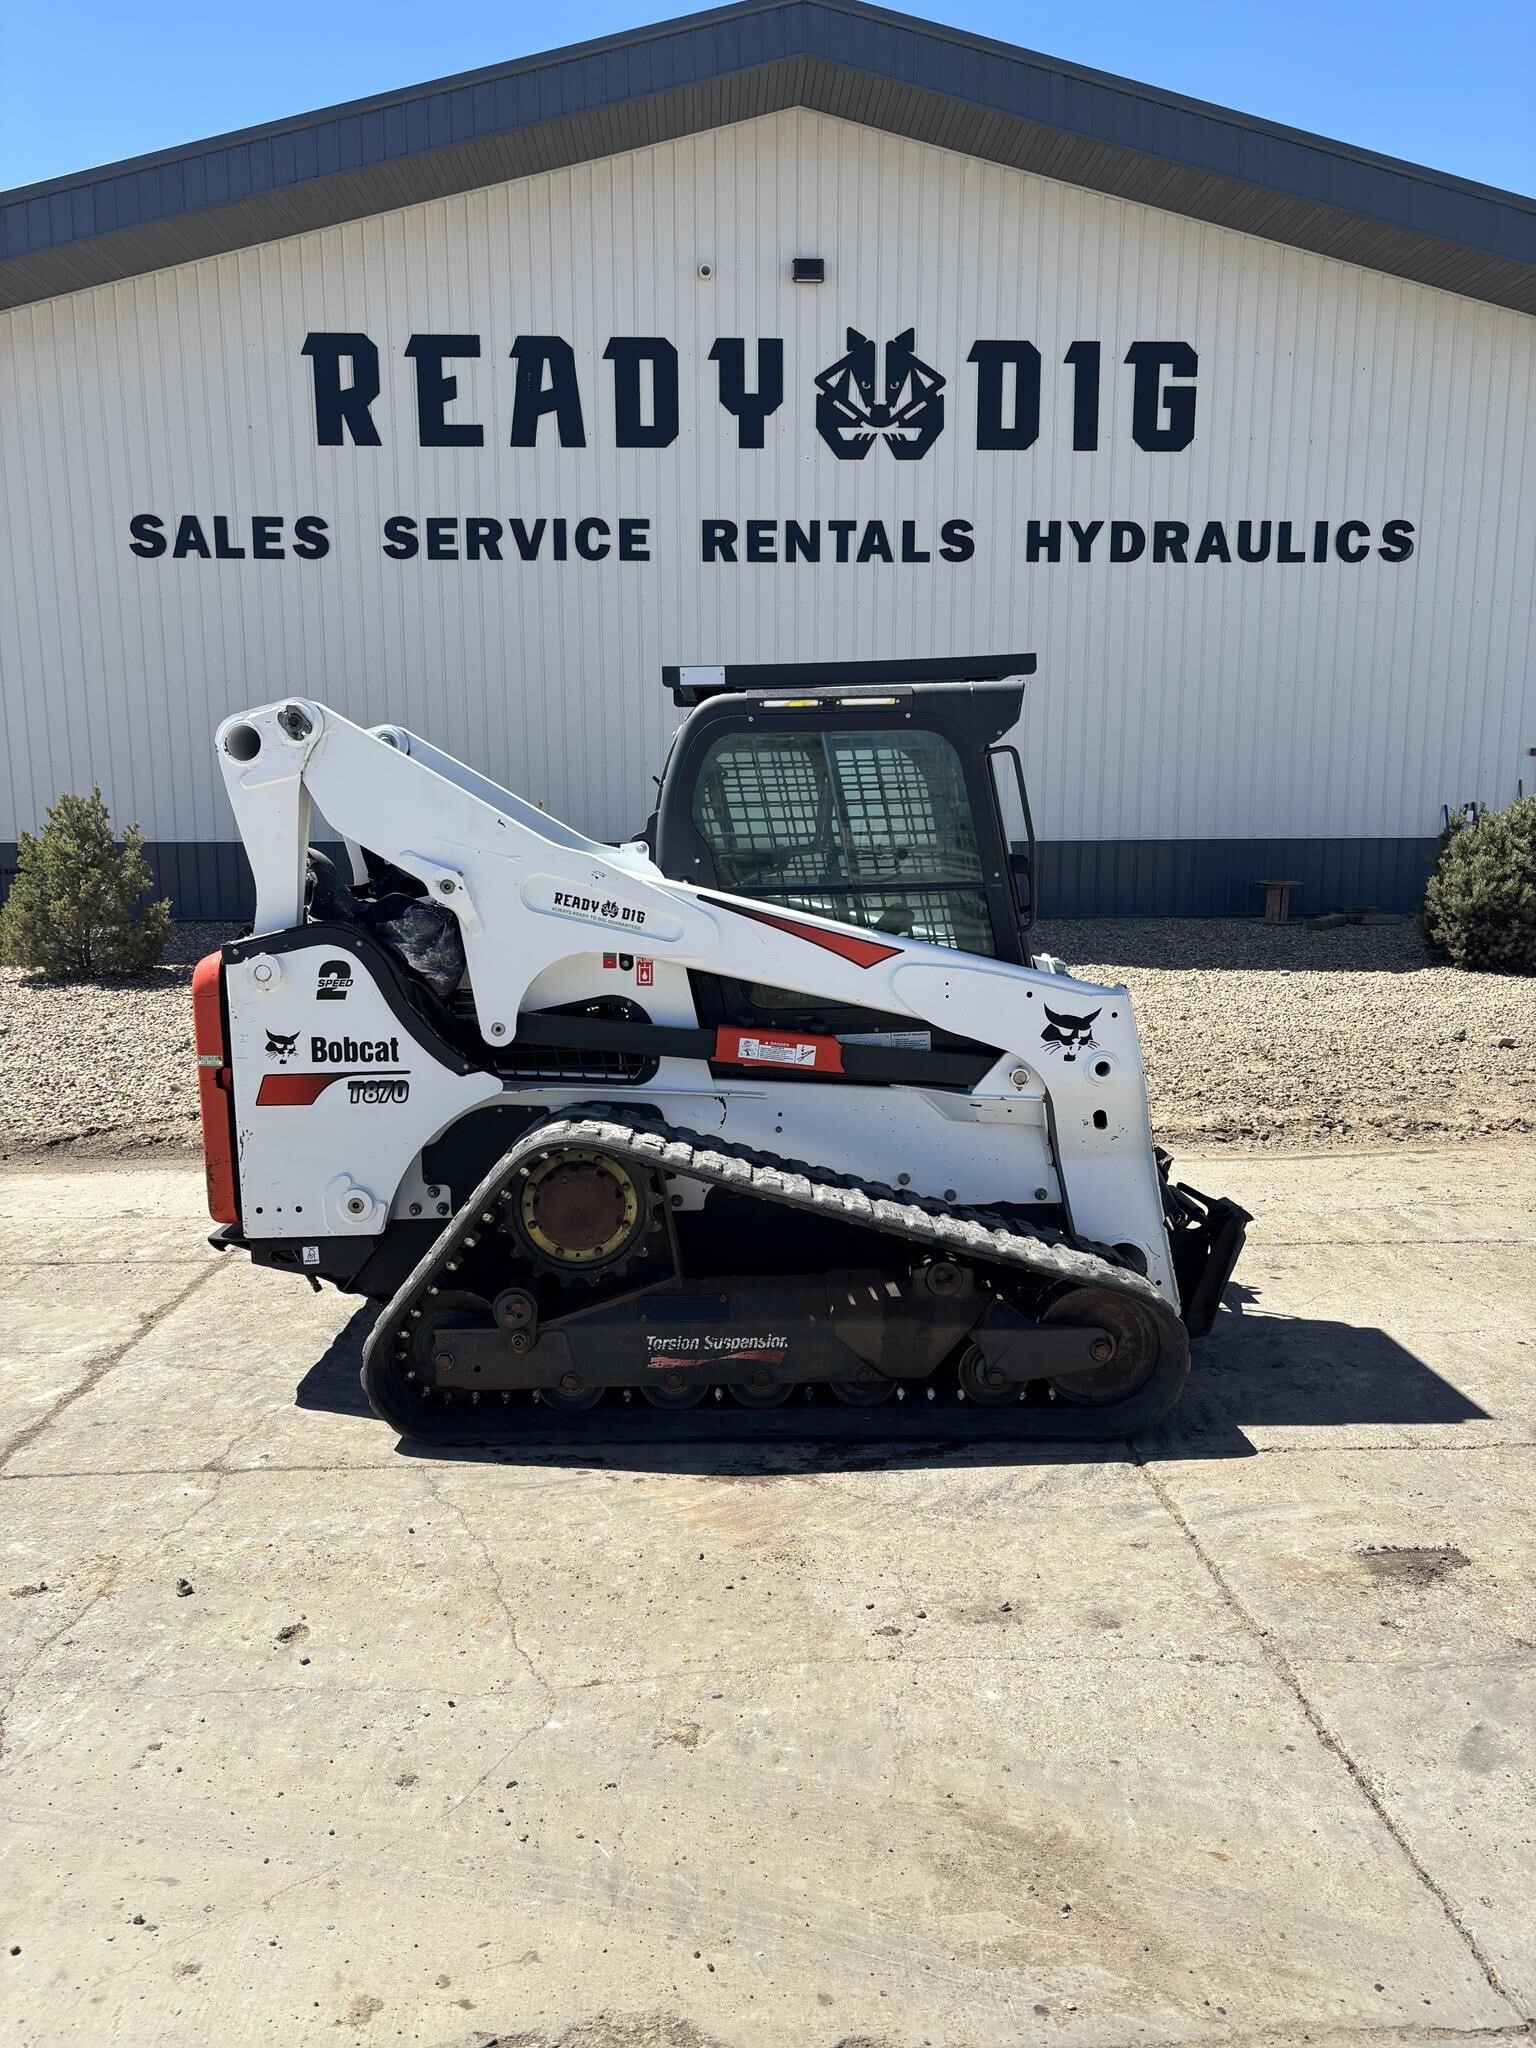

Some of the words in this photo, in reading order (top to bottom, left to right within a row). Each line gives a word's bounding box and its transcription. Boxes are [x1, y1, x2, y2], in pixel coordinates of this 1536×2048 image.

[302, 333, 784, 450] READY
[967, 340, 1199, 453] DIG
[129, 514, 330, 561] SALES
[383, 516, 651, 562] SERVICE
[702, 520, 976, 564] RENTALS
[1026, 520, 1416, 564] HYDRAULICS
[554, 892, 600, 913] READY
[621, 907, 646, 924] DIG
[316, 960, 352, 1001] 2
[317, 978, 354, 988] SPEED
[311, 1037, 400, 1063] Bobcat
[348, 1080, 410, 1104] T870
[647, 1335, 700, 1351] Torsion
[704, 1333, 788, 1351] Suspension
